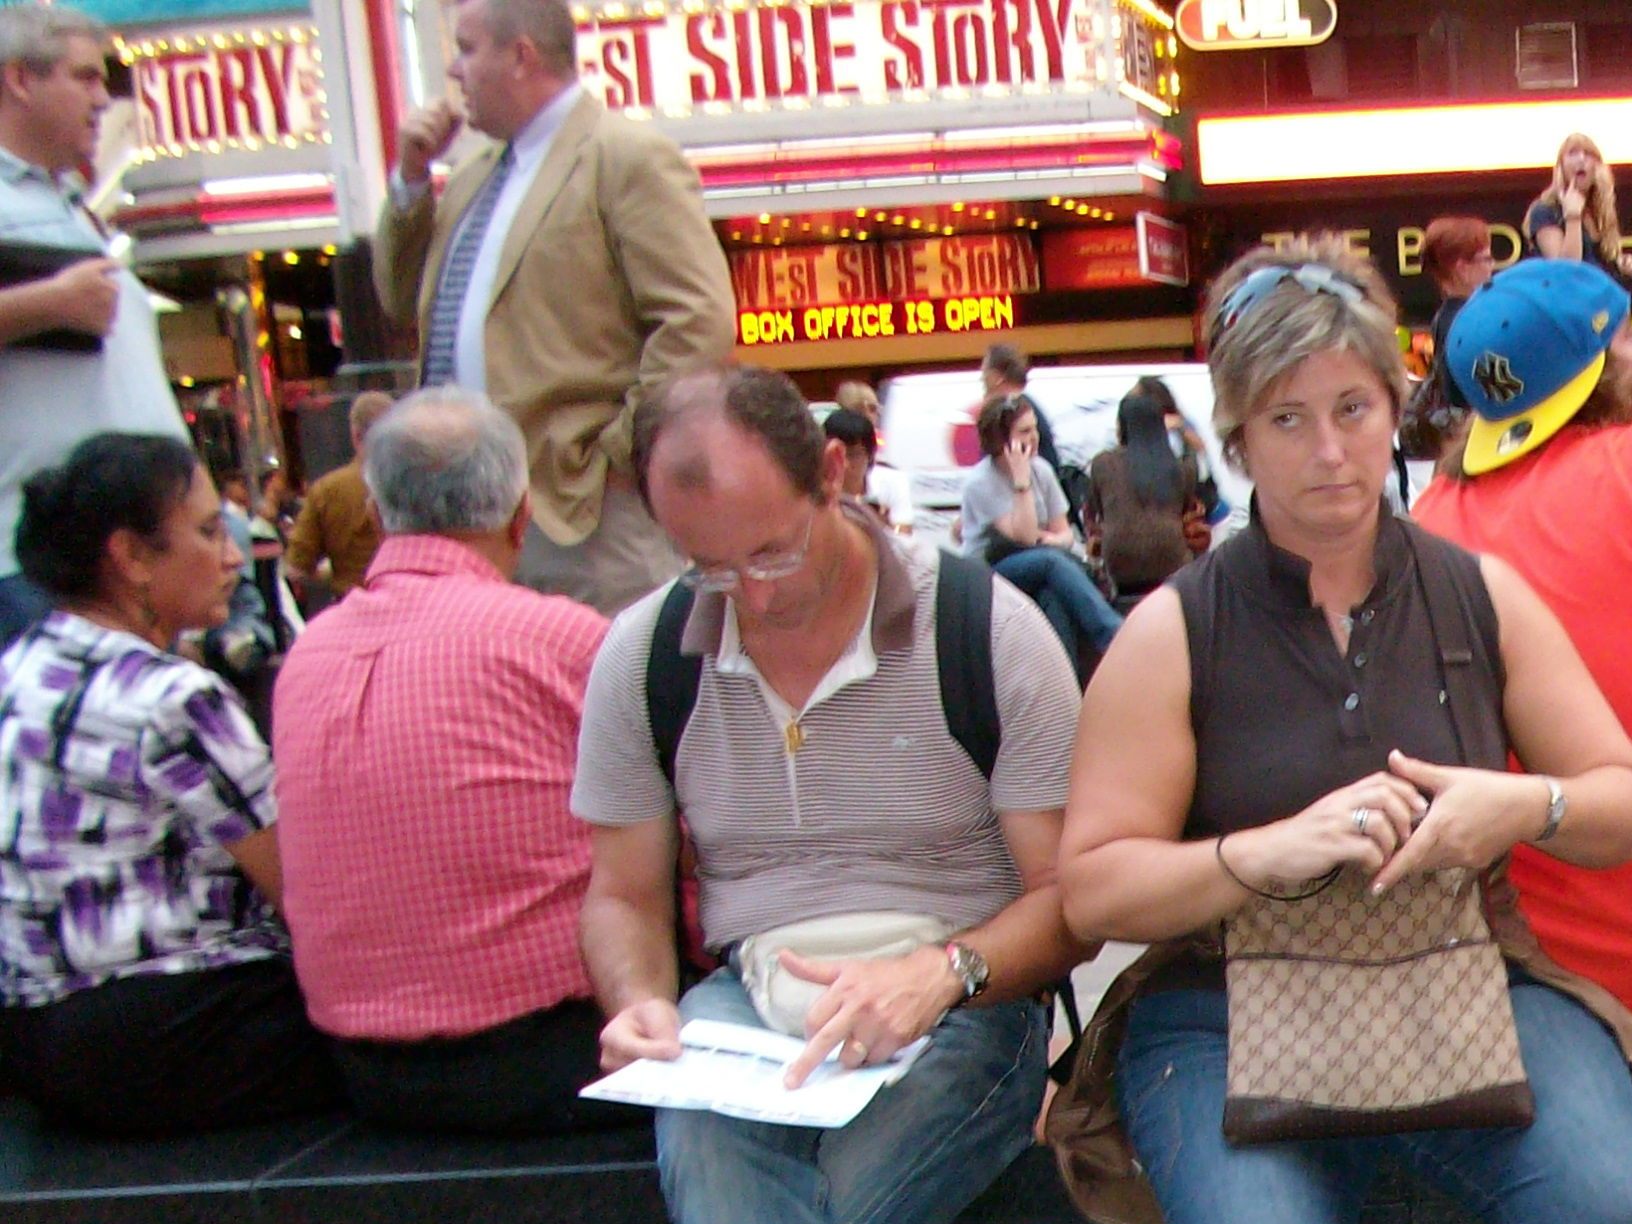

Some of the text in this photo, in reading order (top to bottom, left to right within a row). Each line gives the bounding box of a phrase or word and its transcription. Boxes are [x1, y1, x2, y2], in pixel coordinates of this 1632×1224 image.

[138, 44, 295, 148] STORY
[575, 18, 665, 109] ST
[686, 4, 860, 104] SIDE
[880, 0, 1073, 89] STORY
[732, 234, 1040, 309] WEST SIDE STORY
[741, 295, 1014, 345] BOX OFFICE IS OPEN
